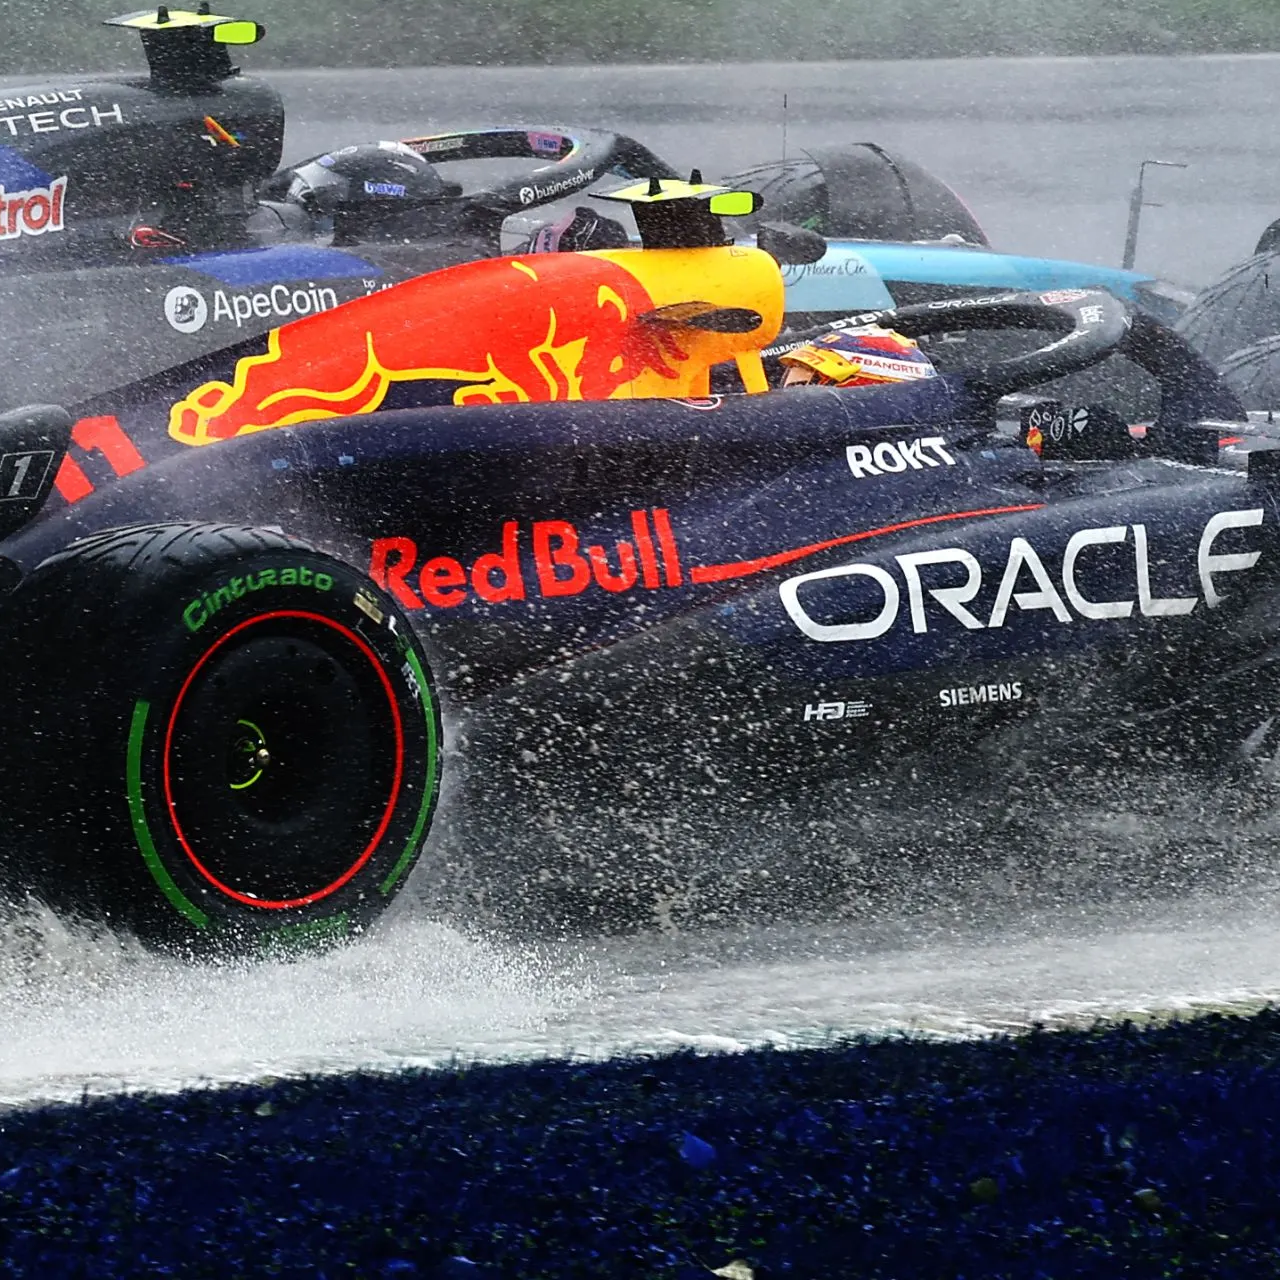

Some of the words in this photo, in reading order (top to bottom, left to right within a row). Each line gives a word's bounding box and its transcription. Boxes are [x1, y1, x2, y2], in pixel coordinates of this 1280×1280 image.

[534, 168, 596, 199] businessolver
[214, 282, 339, 328] ApeCoin
[845, 436, 957, 479] ROKT
[368, 520, 525, 611] Red
[531, 508, 685, 598] Bull
[778, 507, 1266, 643] ORACLE
[938, 681, 1023, 708] SIEMENS
